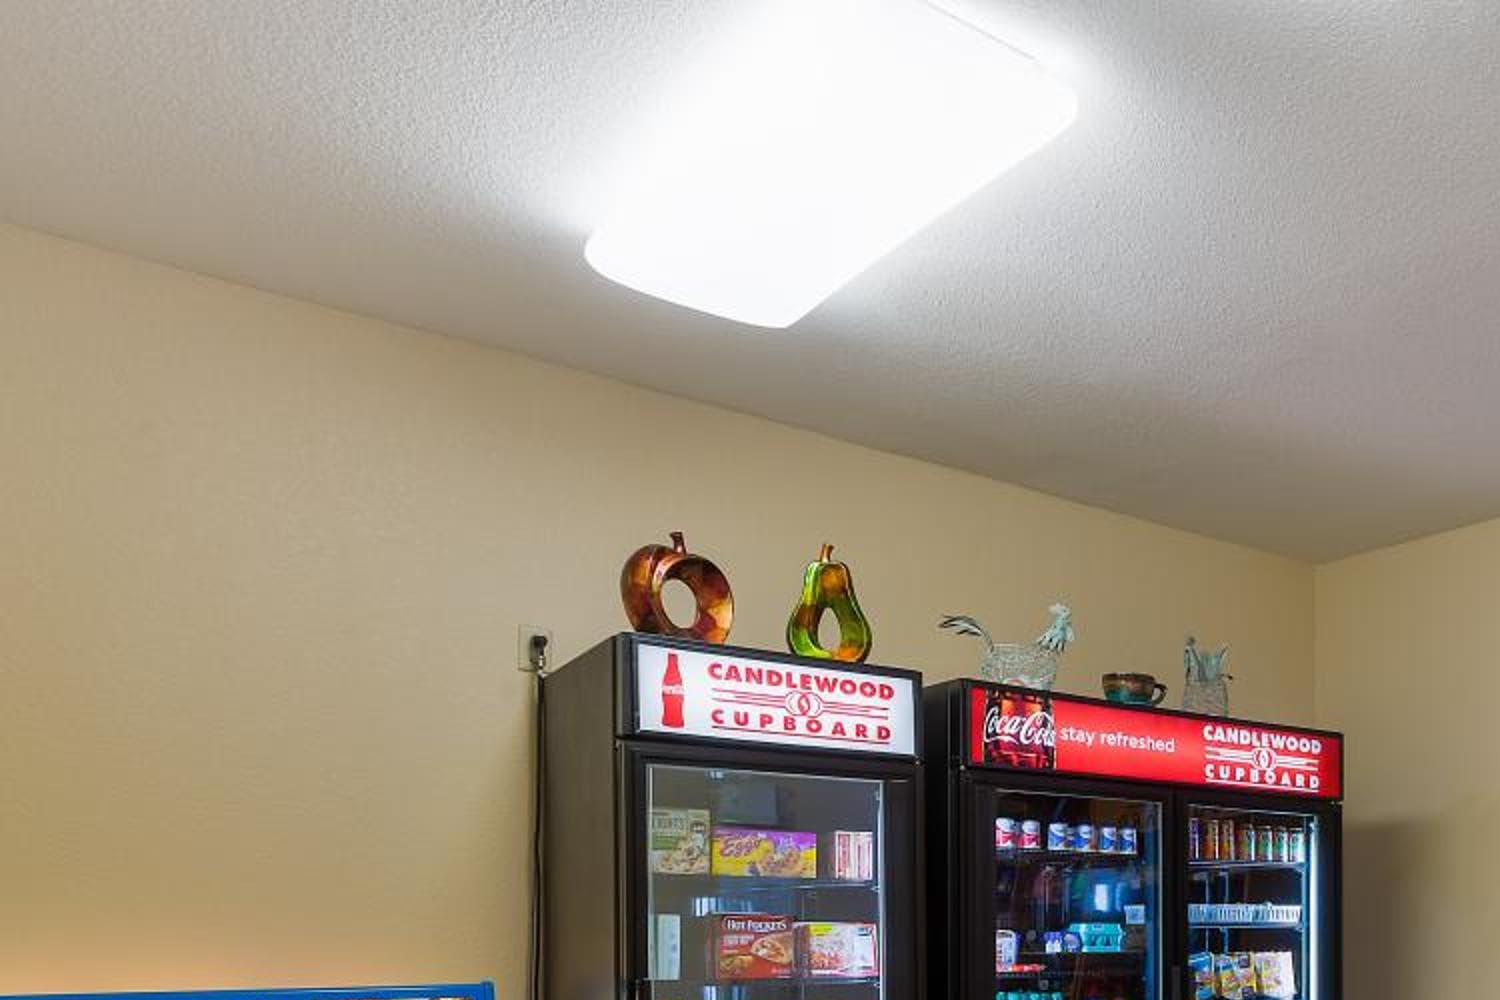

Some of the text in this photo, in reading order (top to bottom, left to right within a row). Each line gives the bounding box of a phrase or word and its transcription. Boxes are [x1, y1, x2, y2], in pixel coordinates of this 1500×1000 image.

[707, 662, 895, 700] CANDLEWOOD
[711, 708, 891, 741] CUPBOARD
[984, 706, 1056, 748] Coca-Cola
[1060, 725, 1175, 753] stay refreshed
[1203, 724, 1321, 754] CANDLEWOOD
[1204, 764, 1320, 791] CUPBOARD
